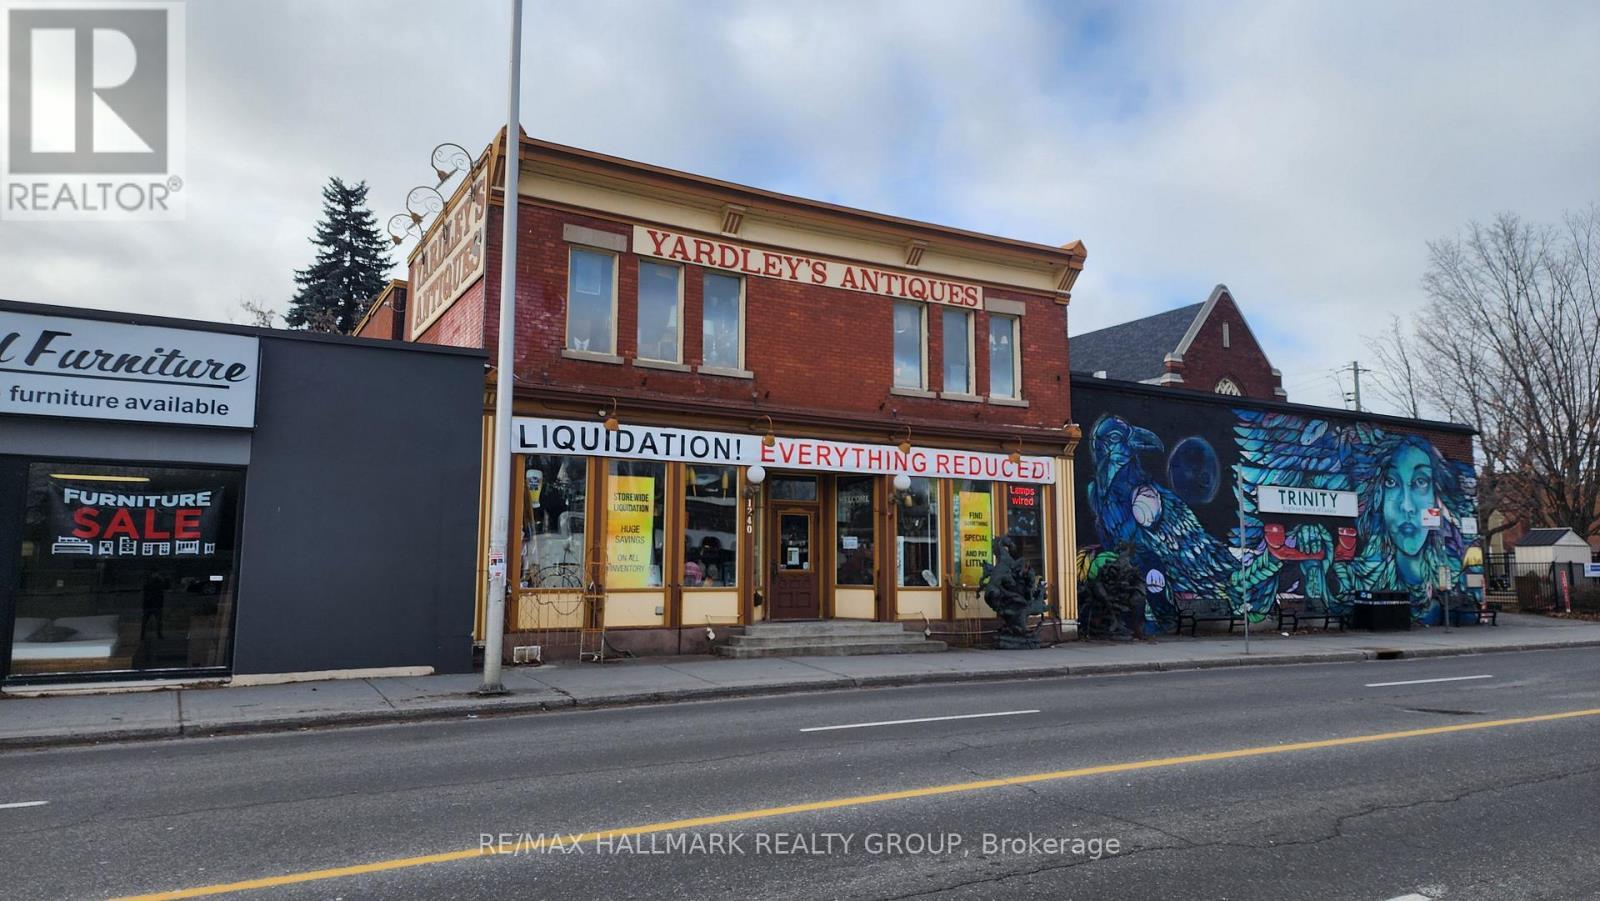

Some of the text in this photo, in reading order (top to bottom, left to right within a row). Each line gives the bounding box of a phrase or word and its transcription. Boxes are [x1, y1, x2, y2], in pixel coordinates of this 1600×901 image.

[647, 230, 978, 307] YARDLEY'S ANTIQUES
[24, 330, 250, 382] Furniture
[10, 385, 229, 416] furniture available
[519, 424, 1051, 480] LIQUIDATION! EVERYTHING REDUCED!
[64, 488, 211, 507] FURNITURE
[1009, 485, 1036, 496] Lamps
[1011, 496, 1034, 506] wired
[1278, 490, 1338, 508] TRINITY
[614, 504, 649, 513] LIQUIDATION
[72, 507, 202, 539] SALE
[621, 525, 641, 534] HUGE
[615, 535, 646, 545] SAVINGS
[964, 534, 987, 542] SPECIAL
[617, 554, 640, 562] ON ALL
